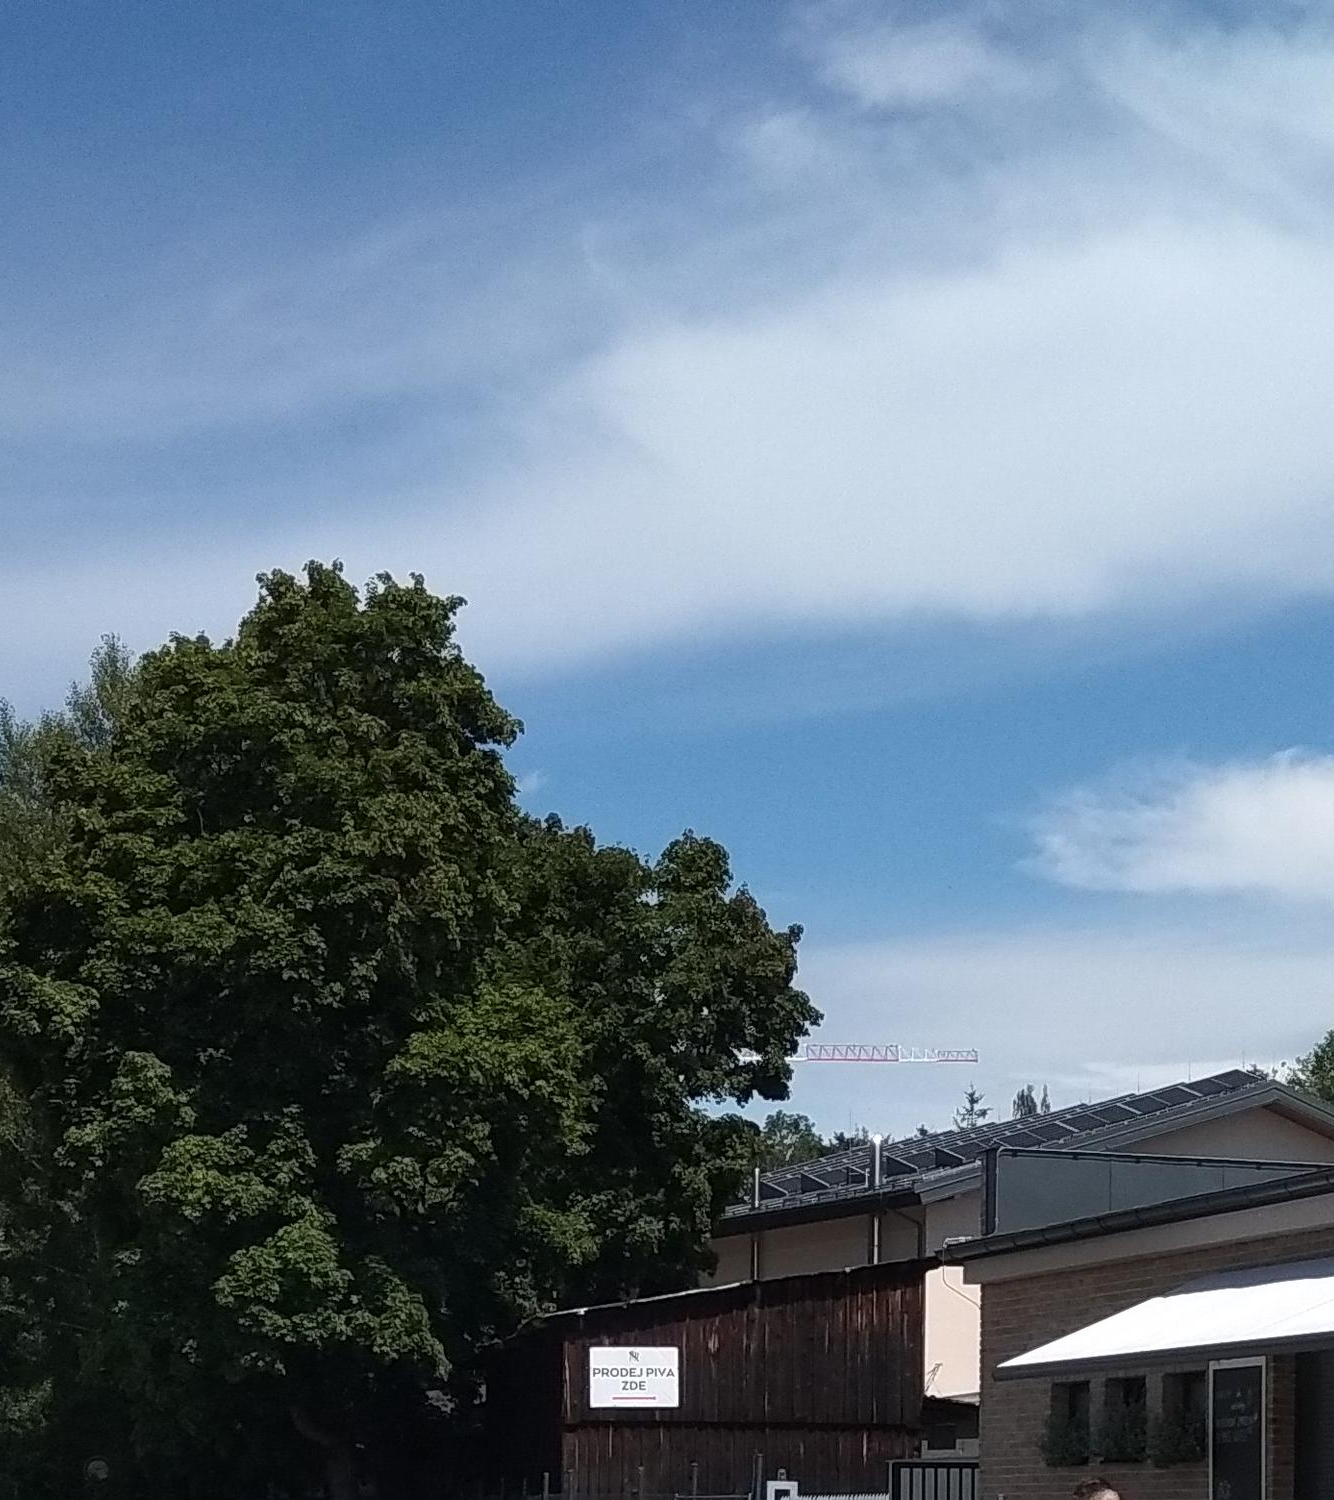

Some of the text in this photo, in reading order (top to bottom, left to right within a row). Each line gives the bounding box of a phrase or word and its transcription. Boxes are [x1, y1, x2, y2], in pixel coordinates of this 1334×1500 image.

[592, 1367, 675, 1378] PRODEJ PIVA
[621, 1381, 647, 1391] ZDE
